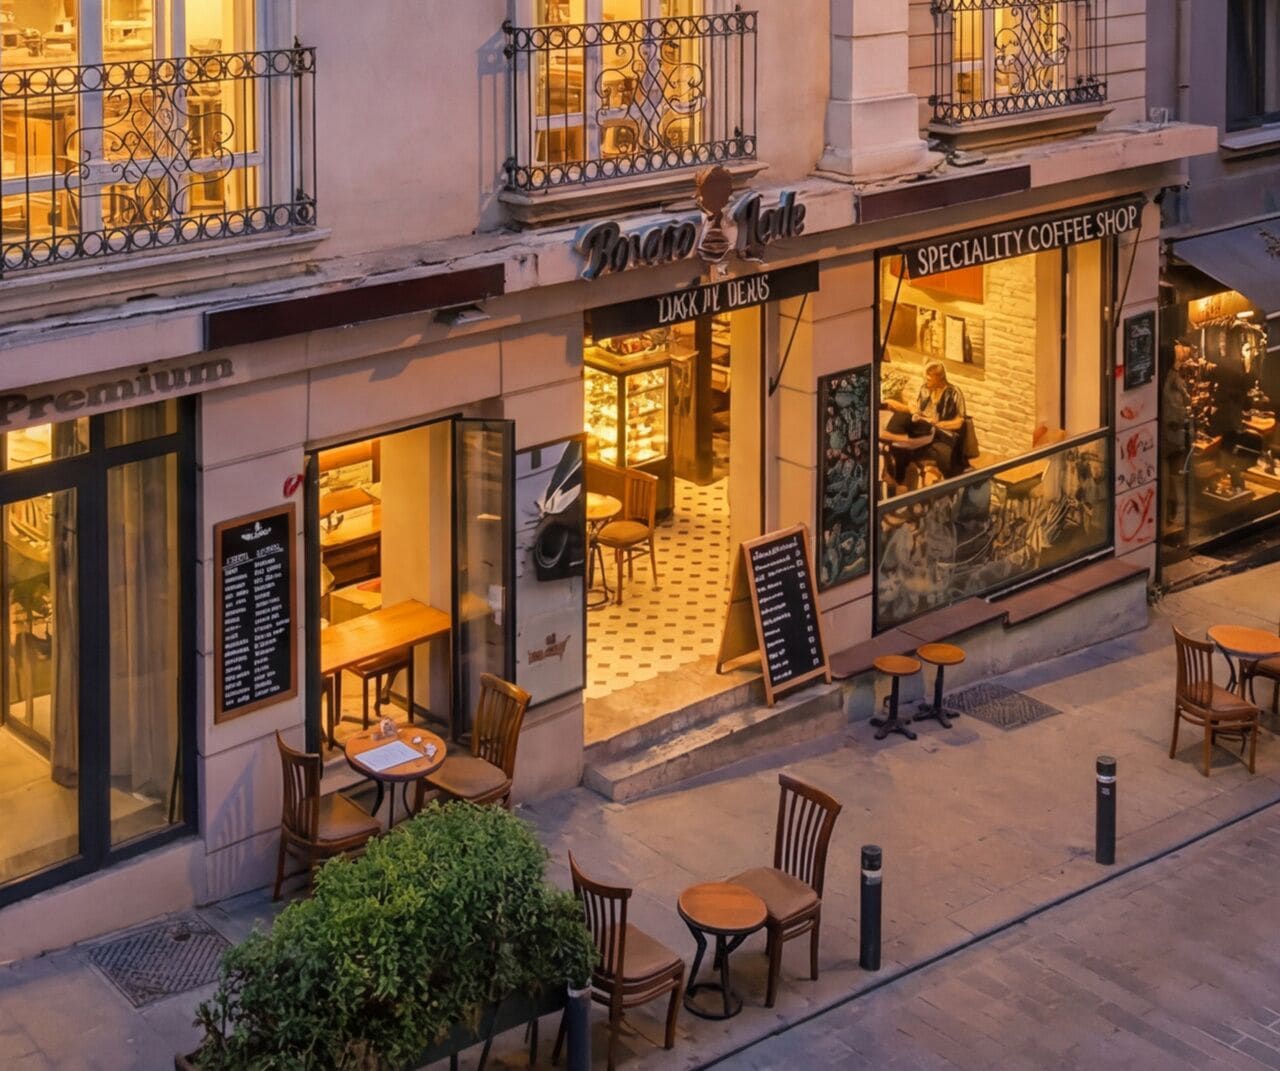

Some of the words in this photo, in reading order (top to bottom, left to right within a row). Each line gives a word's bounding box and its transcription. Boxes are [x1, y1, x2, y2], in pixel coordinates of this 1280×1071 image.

[917, 228, 1023, 275] SPECIALITY
[1028, 214, 1093, 251] COFFEE
[1096, 205, 1137, 238] SHOP
